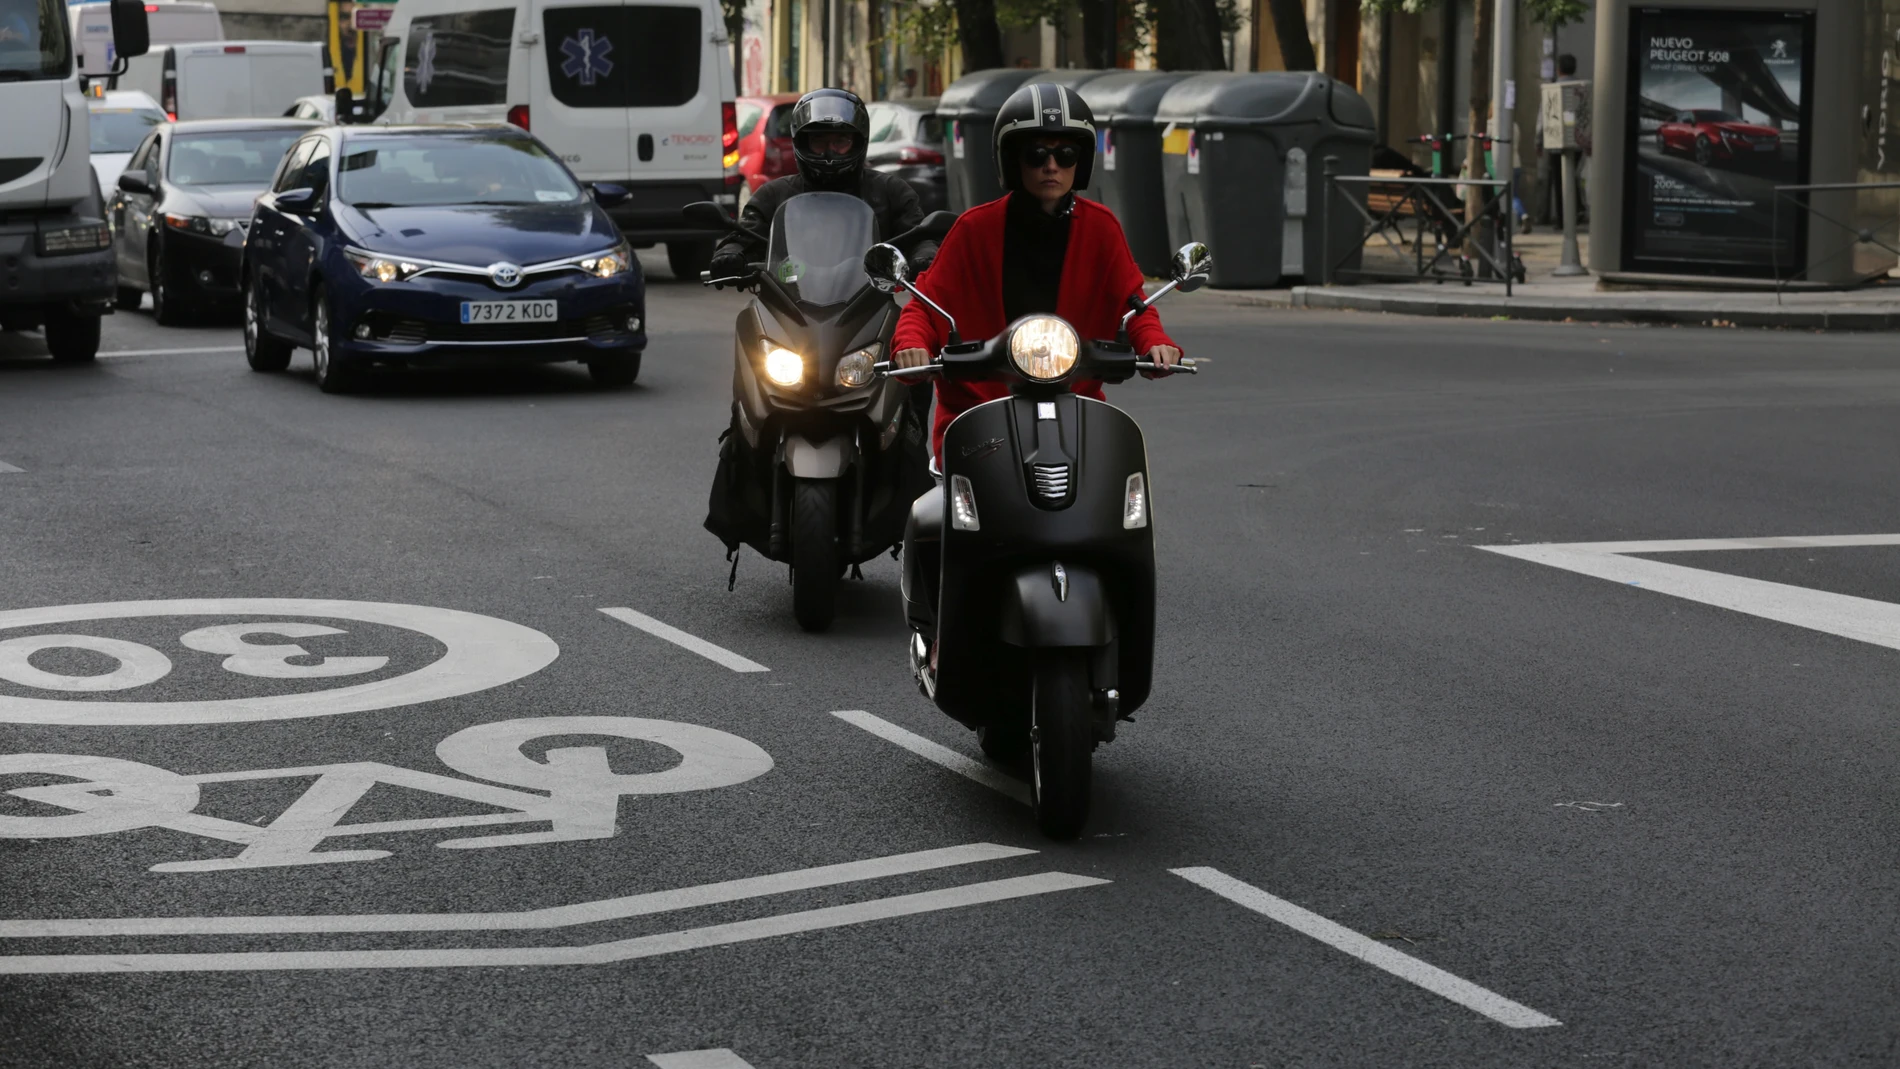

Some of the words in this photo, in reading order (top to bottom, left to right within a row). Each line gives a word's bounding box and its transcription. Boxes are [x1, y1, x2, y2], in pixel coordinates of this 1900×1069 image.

[1650, 37, 1693, 49] NUEVO
[1650, 49, 1704, 62] PEUGEOT
[1707, 51, 1730, 63] 508
[472, 303, 516, 320] 7372
[521, 302, 554, 319] KDC
[0, 621, 390, 693] 30
